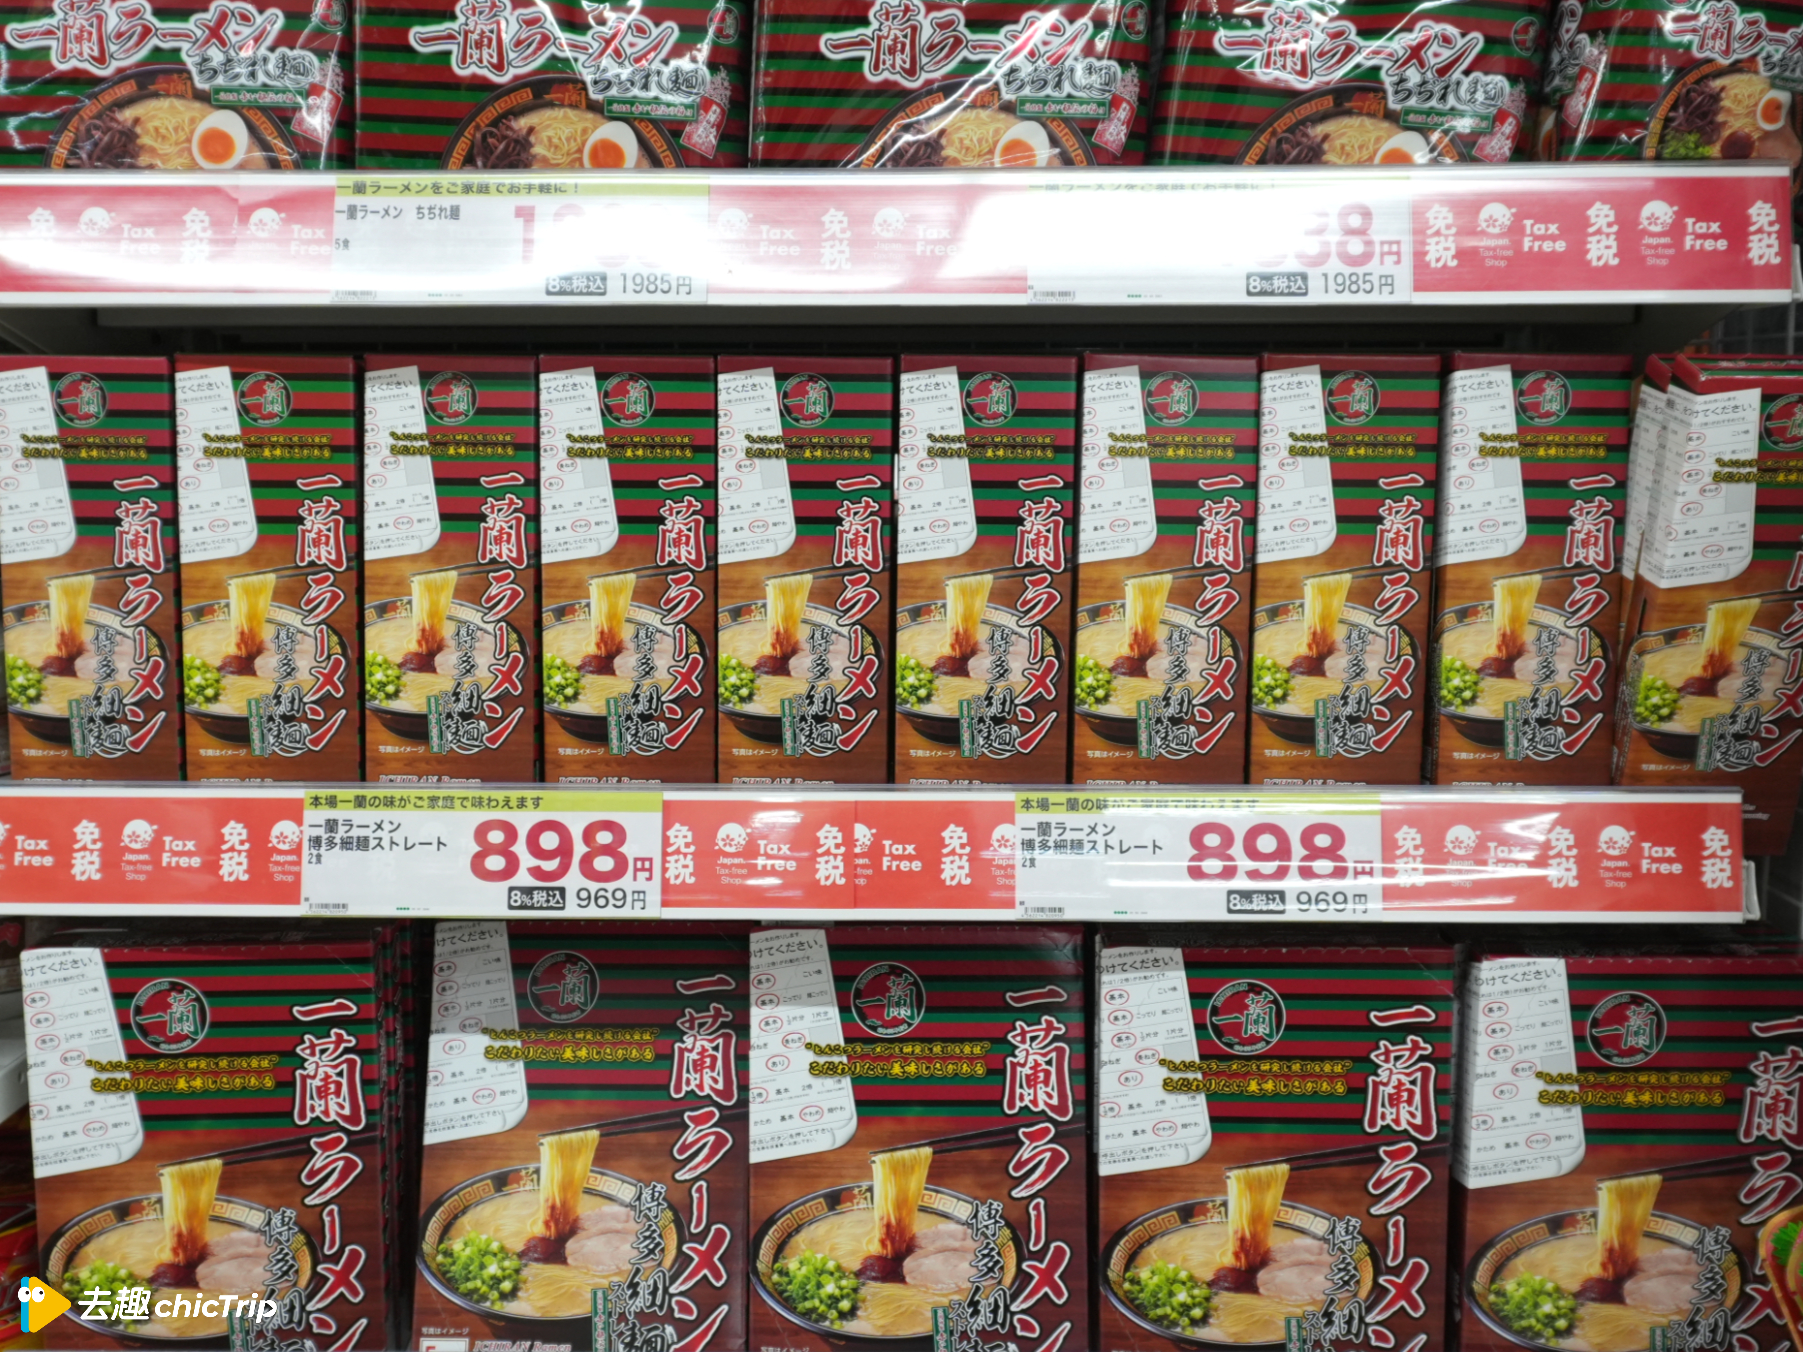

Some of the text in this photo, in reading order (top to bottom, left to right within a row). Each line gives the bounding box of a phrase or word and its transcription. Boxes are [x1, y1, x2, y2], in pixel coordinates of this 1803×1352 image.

[9, 0, 280, 68] 一蘭ラーメン
[824, 1, 1089, 82] 一蘭ラーメン
[1221, 8, 1483, 82] 一蘭ラーメン
[1002, 61, 1119, 99] ちぢれ麺
[1389, 75, 1507, 113] ちぢれ麺
[334, 204, 461, 220] 一蘭ラーメン ちぢれ麺
[121, 223, 156, 239] Tax
[290, 223, 327, 239] Tax
[759, 224, 796, 240] Tax
[1424, 203, 1459, 269] 免税
[1522, 219, 1560, 236] Tax
[1585, 201, 1620, 268] 免税
[1684, 217, 1722, 235] Tax
[1747, 200, 1782, 266] 免税
[119, 239, 162, 255] Free
[758, 241, 801, 257] Free
[820, 207, 852, 271] 免税
[1522, 236, 1567, 253] Free
[1684, 235, 1729, 252] Free
[1484, 258, 1508, 269] Shop
[1646, 256, 1670, 268] Shop
[549, 271, 693, 296] 8%税込 1985円
[1249, 271, 1396, 296] 8%税込 1985円
[57, 380, 101, 415] 一蘭
[241, 379, 287, 415] 一蘭
[604, 380, 651, 415] 一蘭
[967, 380, 1013, 416] 一蘭
[1147, 378, 1194, 414] 一蘭
[1519, 379, 1565, 415] 一蘭
[201, 445, 332, 461] こだわりたい美味しさがある
[925, 445, 1056, 461] こだわりたい美味しさがある
[112, 472, 170, 754] 一蘭ラーメン
[295, 472, 349, 753] 一蘭ラーメン
[477, 470, 527, 752] 一蘭ラーメン
[655, 472, 707, 753] 一蘭ラーメン
[832, 473, 883, 753] 一蘭ラーメン
[1013, 473, 1065, 754] 一蘭ラーメン
[1192, 472, 1245, 755] 一蘭ラーメン
[1371, 471, 1425, 753] 一蘭ラーメン
[1561, 472, 1616, 757] 一蘭ラーメン
[308, 794, 545, 811] 本場一蘭の味がご家庭で味わえます
[307, 818, 402, 836] 一蘭ラーメン
[1019, 820, 1117, 838] 一蘭ラーメン
[14, 834, 49, 851] Tax
[70, 818, 103, 883] 免税
[162, 835, 198, 852] Tax
[218, 819, 251, 883] 免税
[307, 834, 449, 853] 博多細麺ストレート
[469, 817, 655, 885] 898円
[664, 821, 697, 886] 免税
[756, 839, 792, 856] Tax
[882, 839, 917, 856] Tax
[1019, 837, 1165, 857] 博多細麺ストレート
[1186, 820, 1376, 884] 898円
[1640, 842, 1677, 858] Tax
[13, 851, 55, 868] Free
[119, 862, 153, 872] Tax-free
[161, 852, 203, 869] Free
[307, 852, 324, 866] 2食
[756, 856, 798, 872] Free
[814, 823, 847, 888] 免税
[881, 856, 923, 872] Free
[940, 823, 973, 888] 免税
[1020, 855, 1037, 870] 2食
[1546, 824, 1581, 889] 免税
[1640, 858, 1684, 875] Free
[1700, 825, 1735, 890] 免税
[125, 872, 147, 883] Shop
[715, 866, 749, 876] Tax-free
[720, 876, 743, 887] Shop
[1599, 868, 1633, 879] Tax-free
[1604, 878, 1628, 890] Shop
[509, 886, 648, 911] 8%税込 969円
[1228, 889, 1369, 915] 8%税込 969円
[531, 961, 591, 1011] 一蘭
[856, 973, 919, 1024] 一蘭
[135, 989, 201, 1040] 一蘭
[1211, 992, 1277, 1043] 一蘭
[483, 1043, 655, 1062] こだわりたい美味しさがある
[808, 1059, 988, 1079] こだわりたい美味しさがある
[90, 1074, 276, 1094] こだわりたい美味しさがある
[1162, 1076, 1349, 1096] こだわりたい美味しさがある
[291, 997, 369, 1352] 一蘭ラーメン
[669, 973, 739, 1352] 一蘭ラーメン
